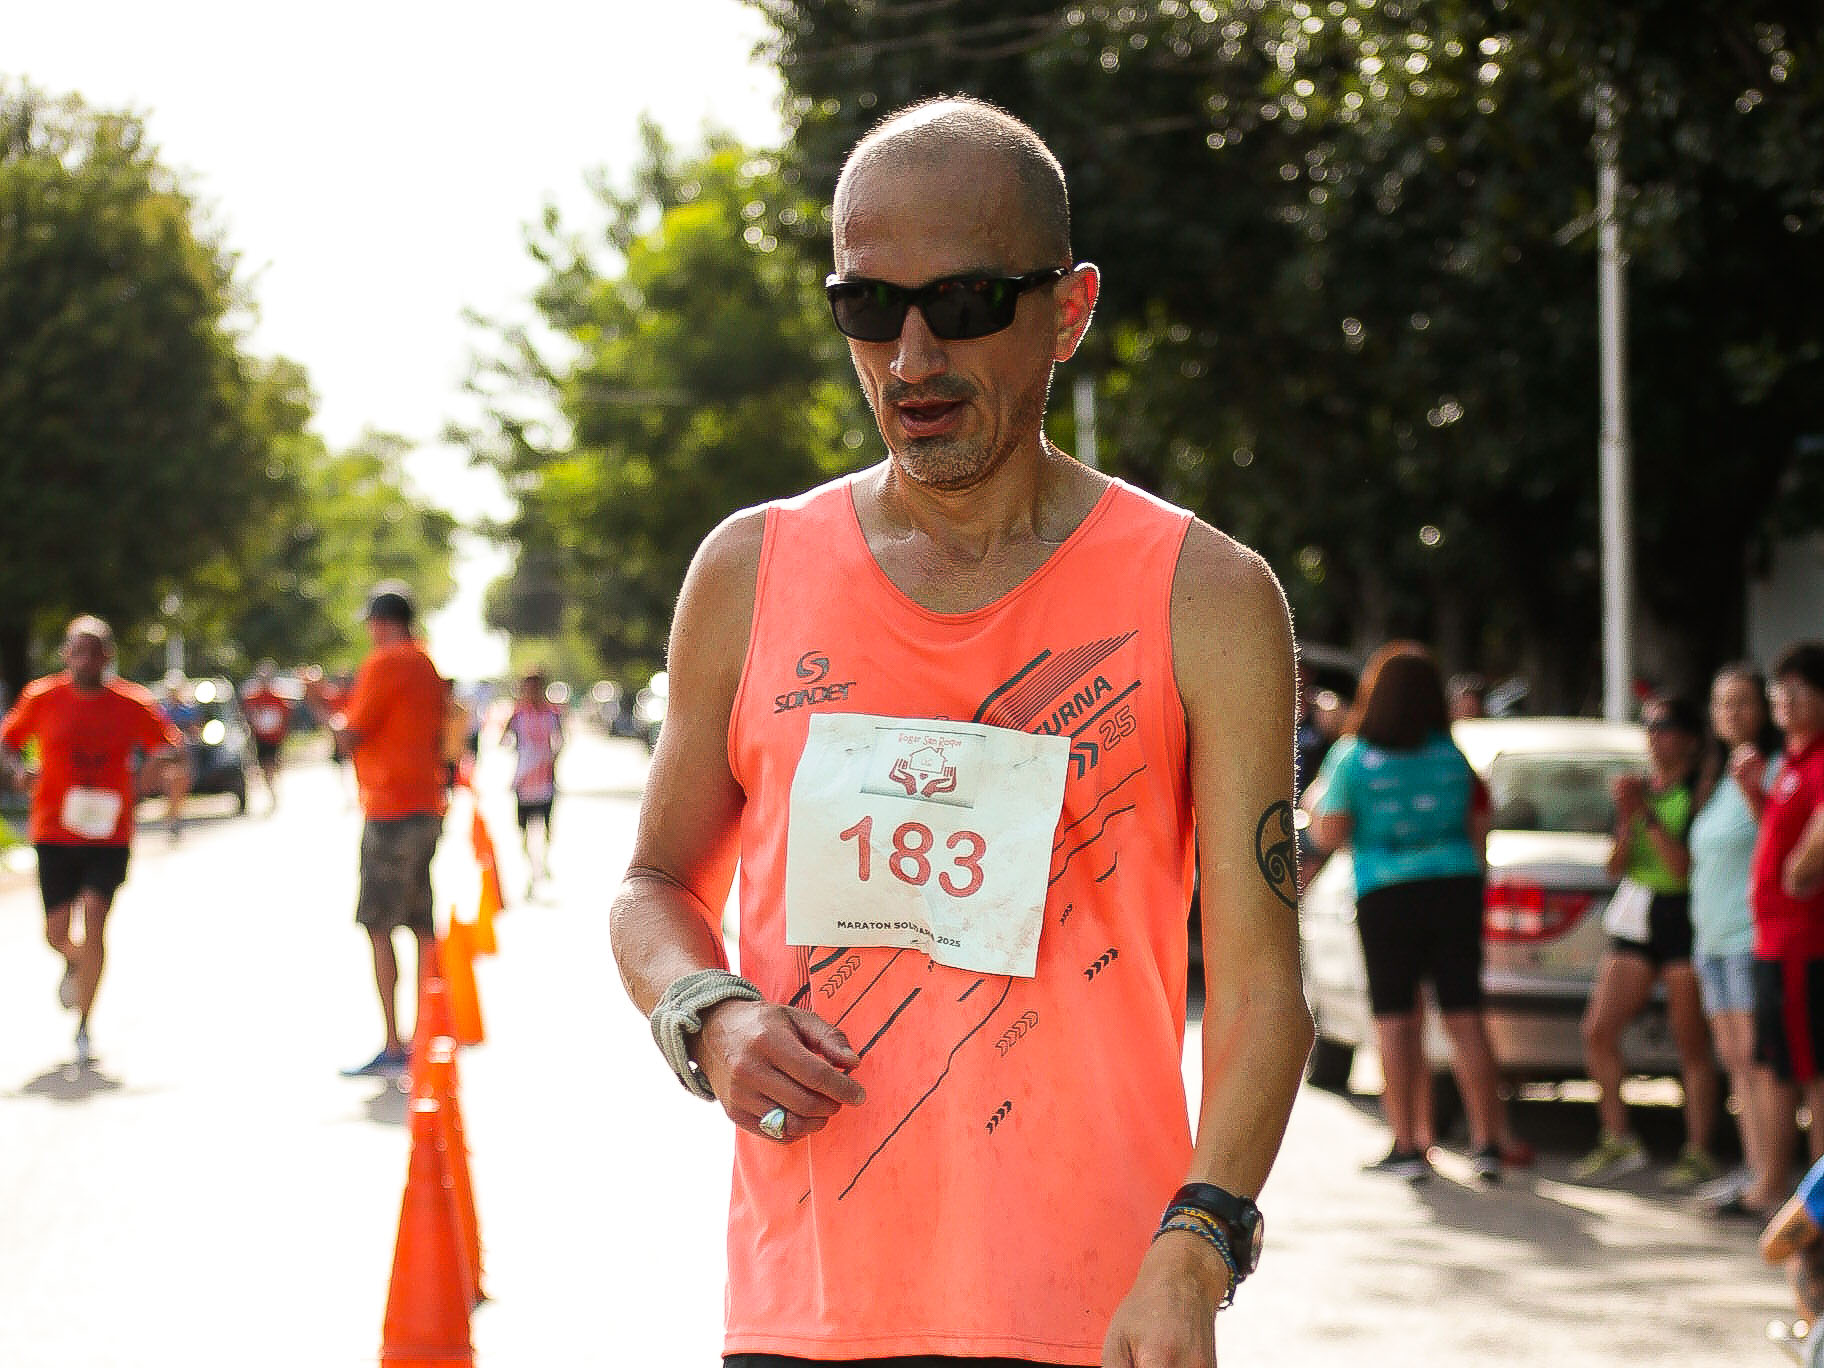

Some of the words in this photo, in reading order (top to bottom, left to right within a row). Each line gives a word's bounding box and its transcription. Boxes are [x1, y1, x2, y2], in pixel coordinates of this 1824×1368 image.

[839, 815, 987, 897] 183
[837, 921, 892, 930] MARATON
[936, 935, 961, 948] 2025
